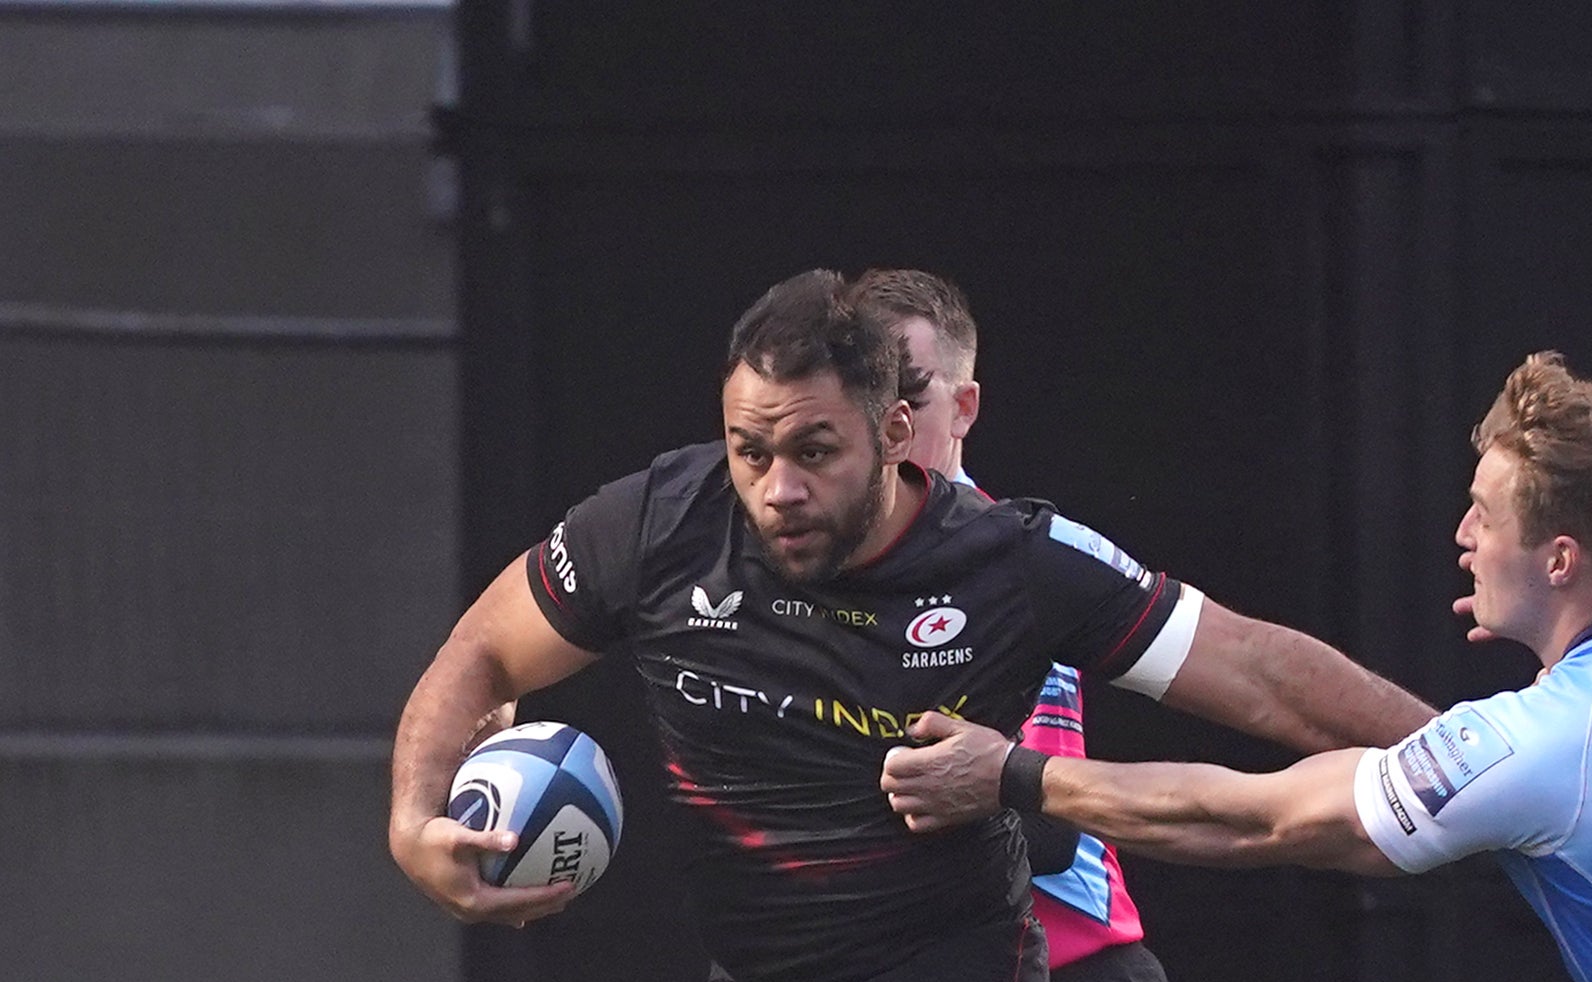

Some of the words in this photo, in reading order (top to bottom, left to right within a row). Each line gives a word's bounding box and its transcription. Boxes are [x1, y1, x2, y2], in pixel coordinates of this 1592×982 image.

[771, 598, 815, 617] CITY
[902, 647, 973, 669] SARACENS
[675, 669, 794, 719] CITY
